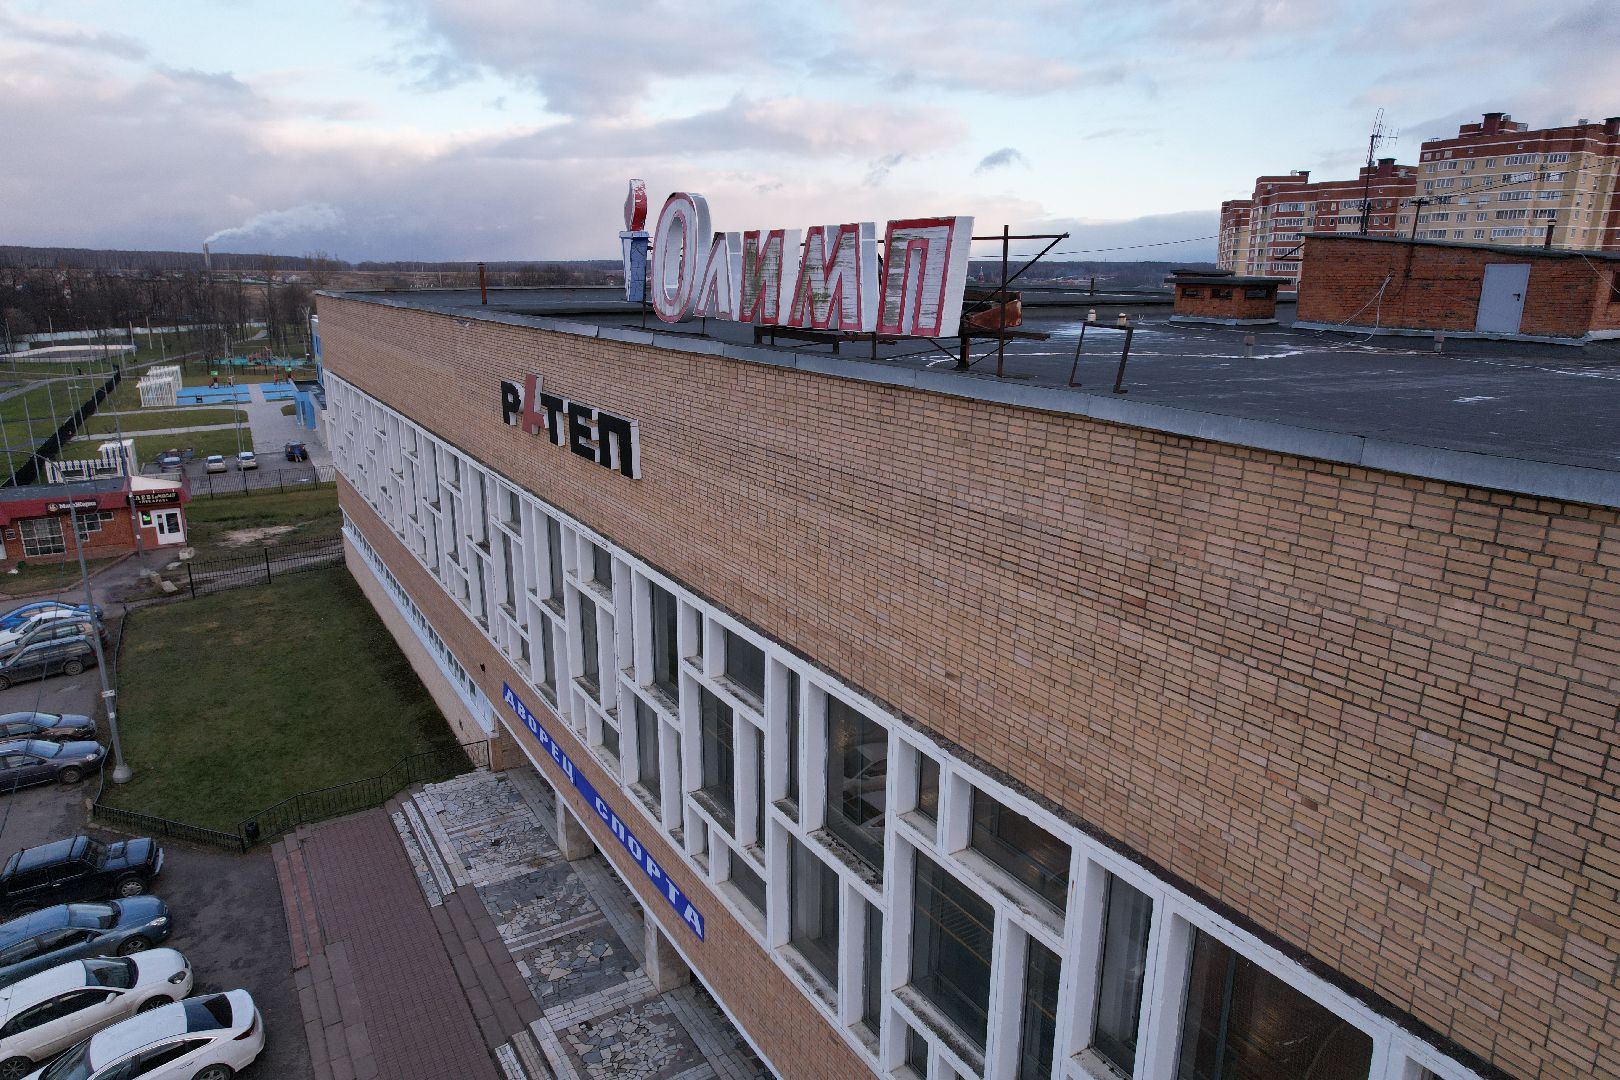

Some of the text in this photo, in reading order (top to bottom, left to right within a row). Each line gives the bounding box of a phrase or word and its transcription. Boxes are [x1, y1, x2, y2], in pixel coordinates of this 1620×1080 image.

[651, 191, 974, 337] ОЛИМП
[500, 374, 641, 480] РАТЕП
[504, 688, 704, 941] ДВОРЕЦ СПОРТА
